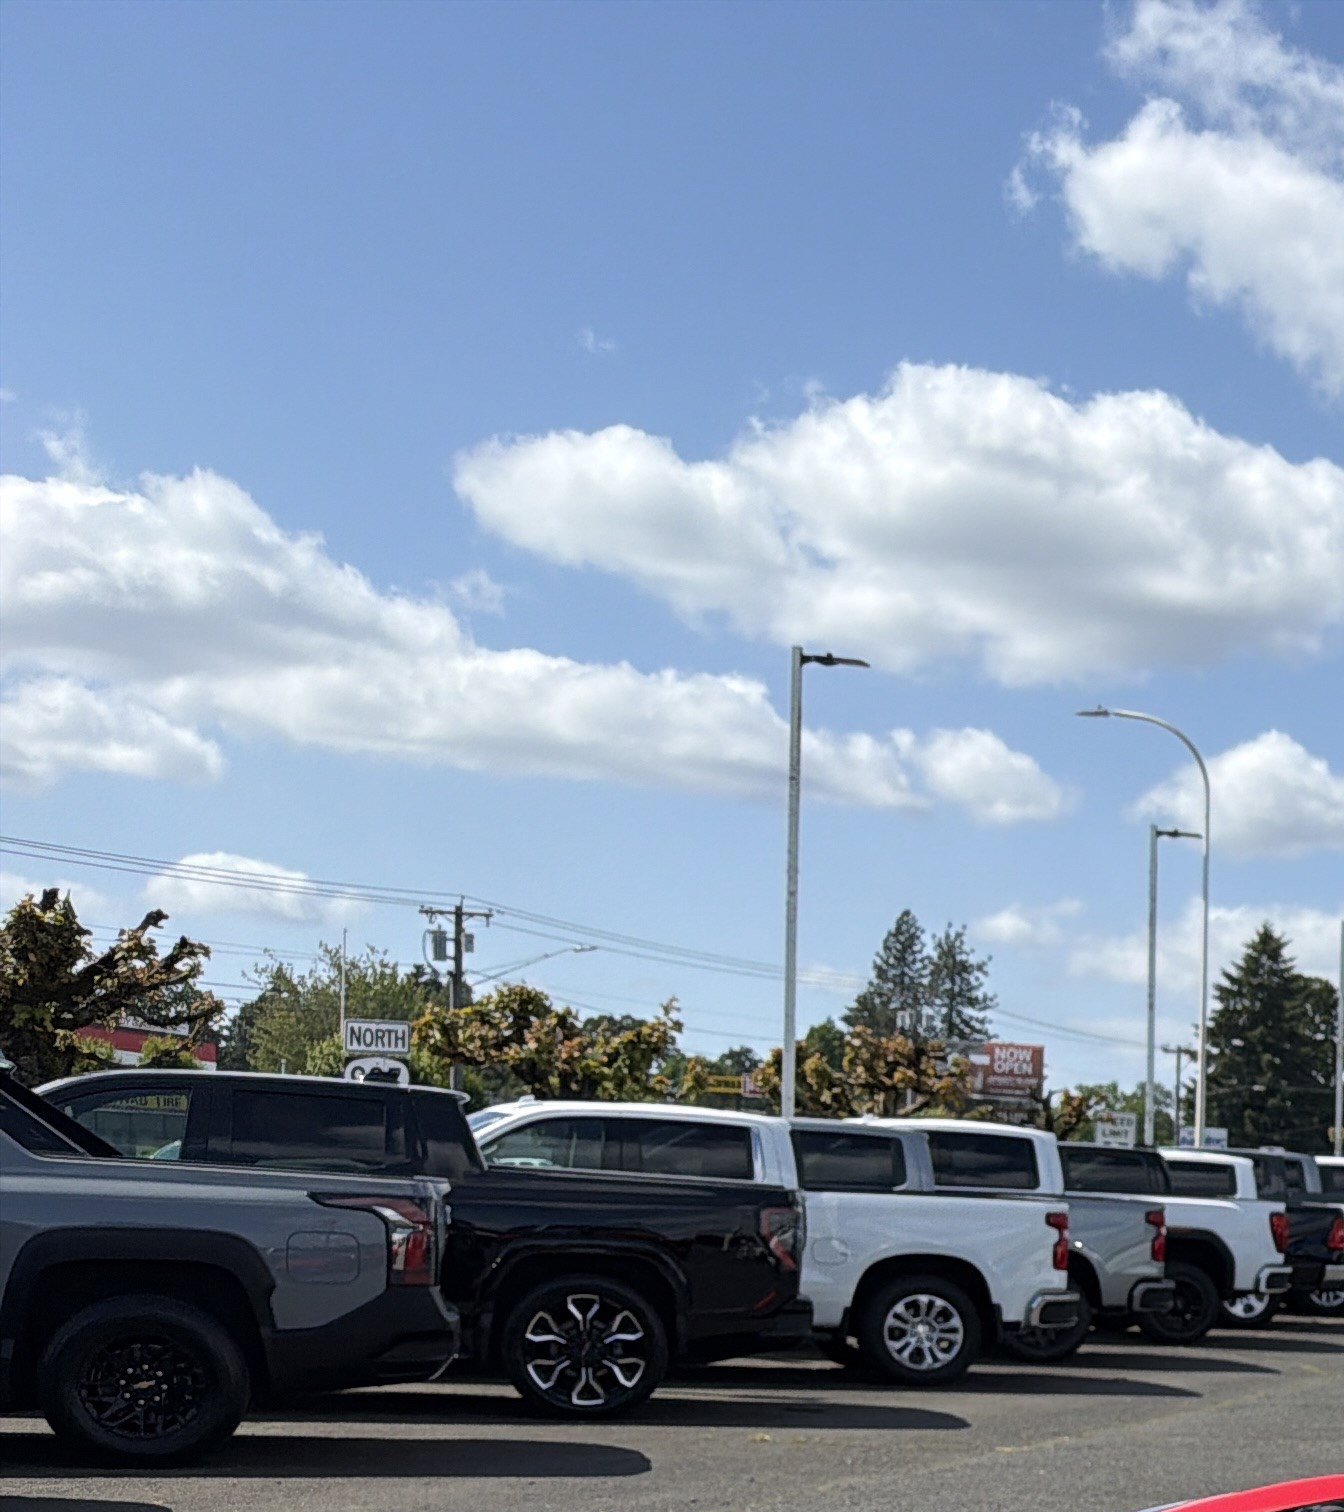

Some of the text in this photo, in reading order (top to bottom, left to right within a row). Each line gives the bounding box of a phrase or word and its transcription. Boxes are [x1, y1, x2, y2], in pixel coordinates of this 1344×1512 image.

[349, 1025, 406, 1049] NORTH
[994, 1045, 1032, 1062] NOW
[994, 1060, 1033, 1075] OPEN
